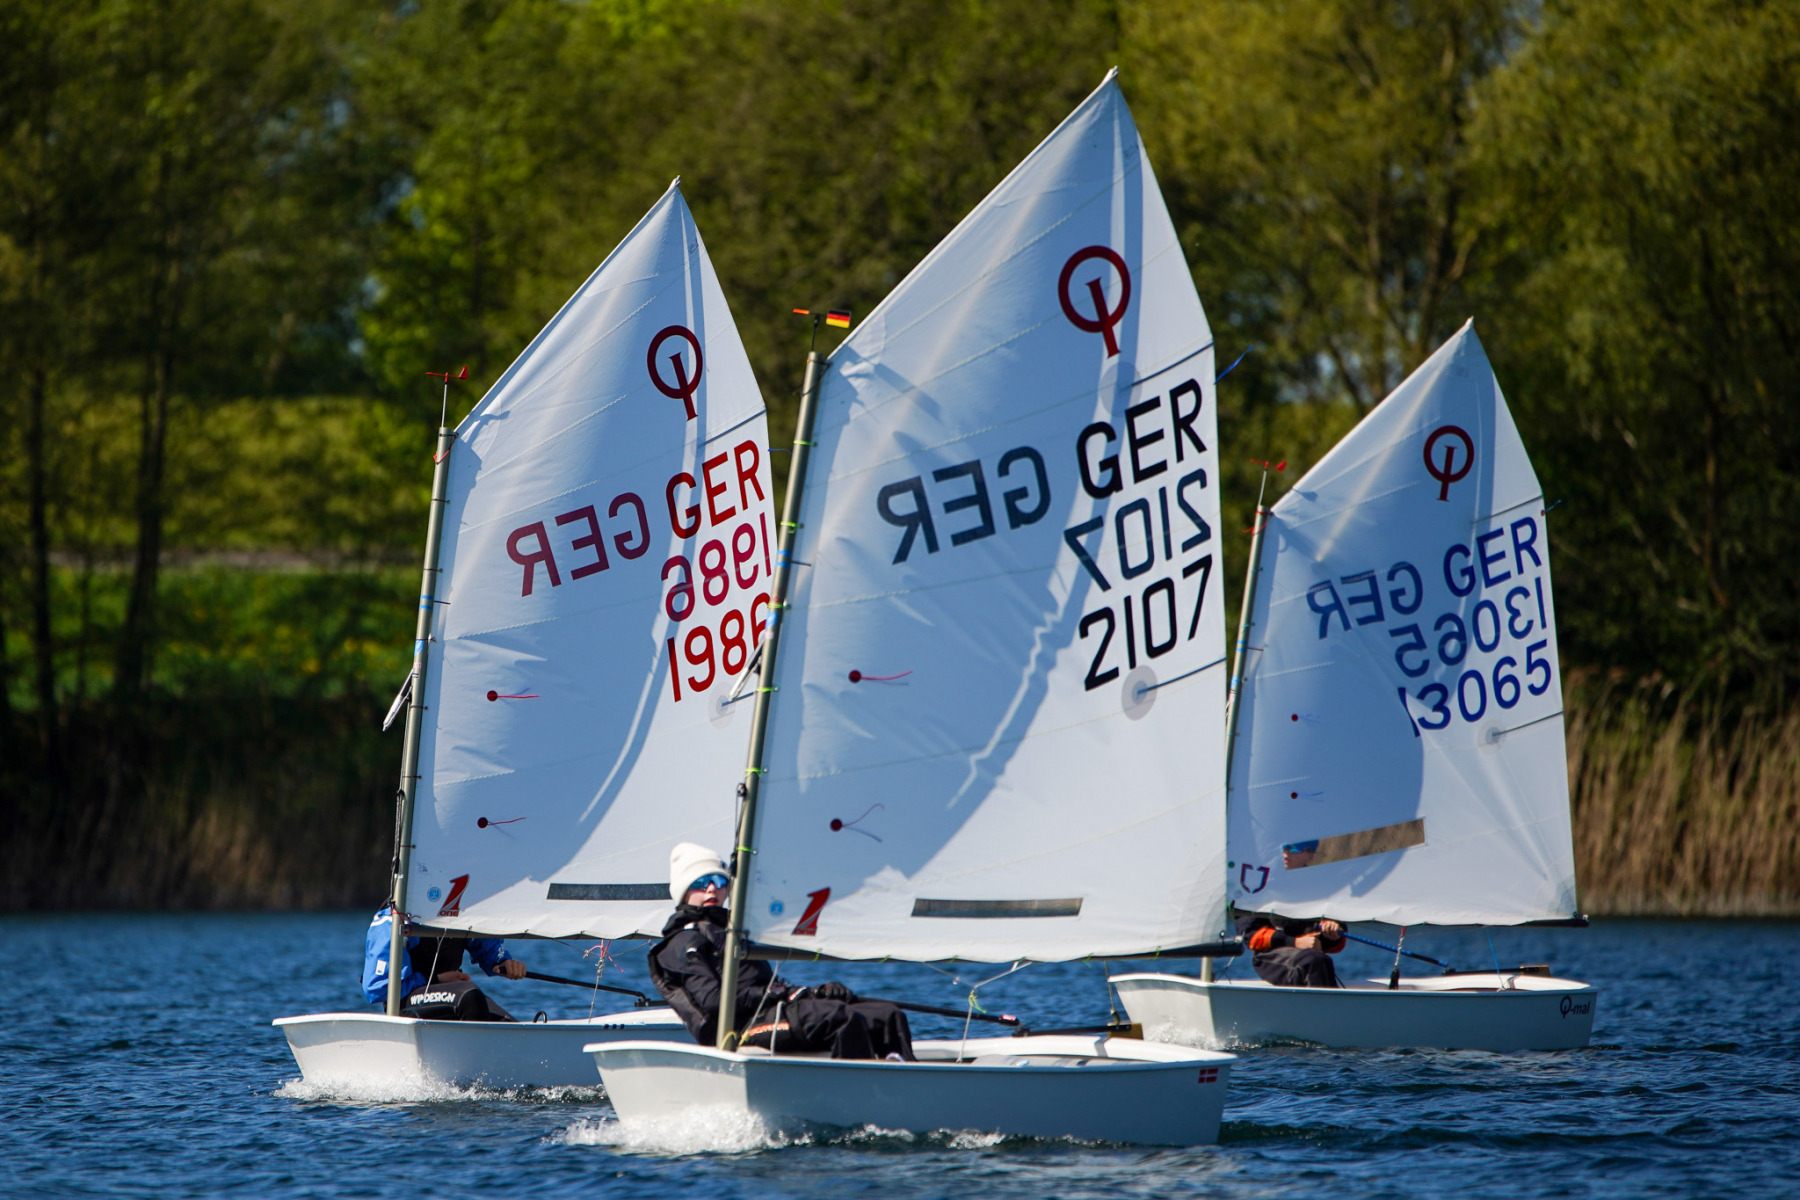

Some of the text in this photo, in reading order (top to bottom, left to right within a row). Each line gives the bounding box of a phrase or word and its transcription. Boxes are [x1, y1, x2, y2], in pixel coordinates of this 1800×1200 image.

[1076, 378, 1207, 500] GER
[665, 440, 765, 539] GER
[1443, 516, 1542, 598] GER
[1078, 553, 1213, 692] 2107
[1397, 638, 1552, 738] 13065
